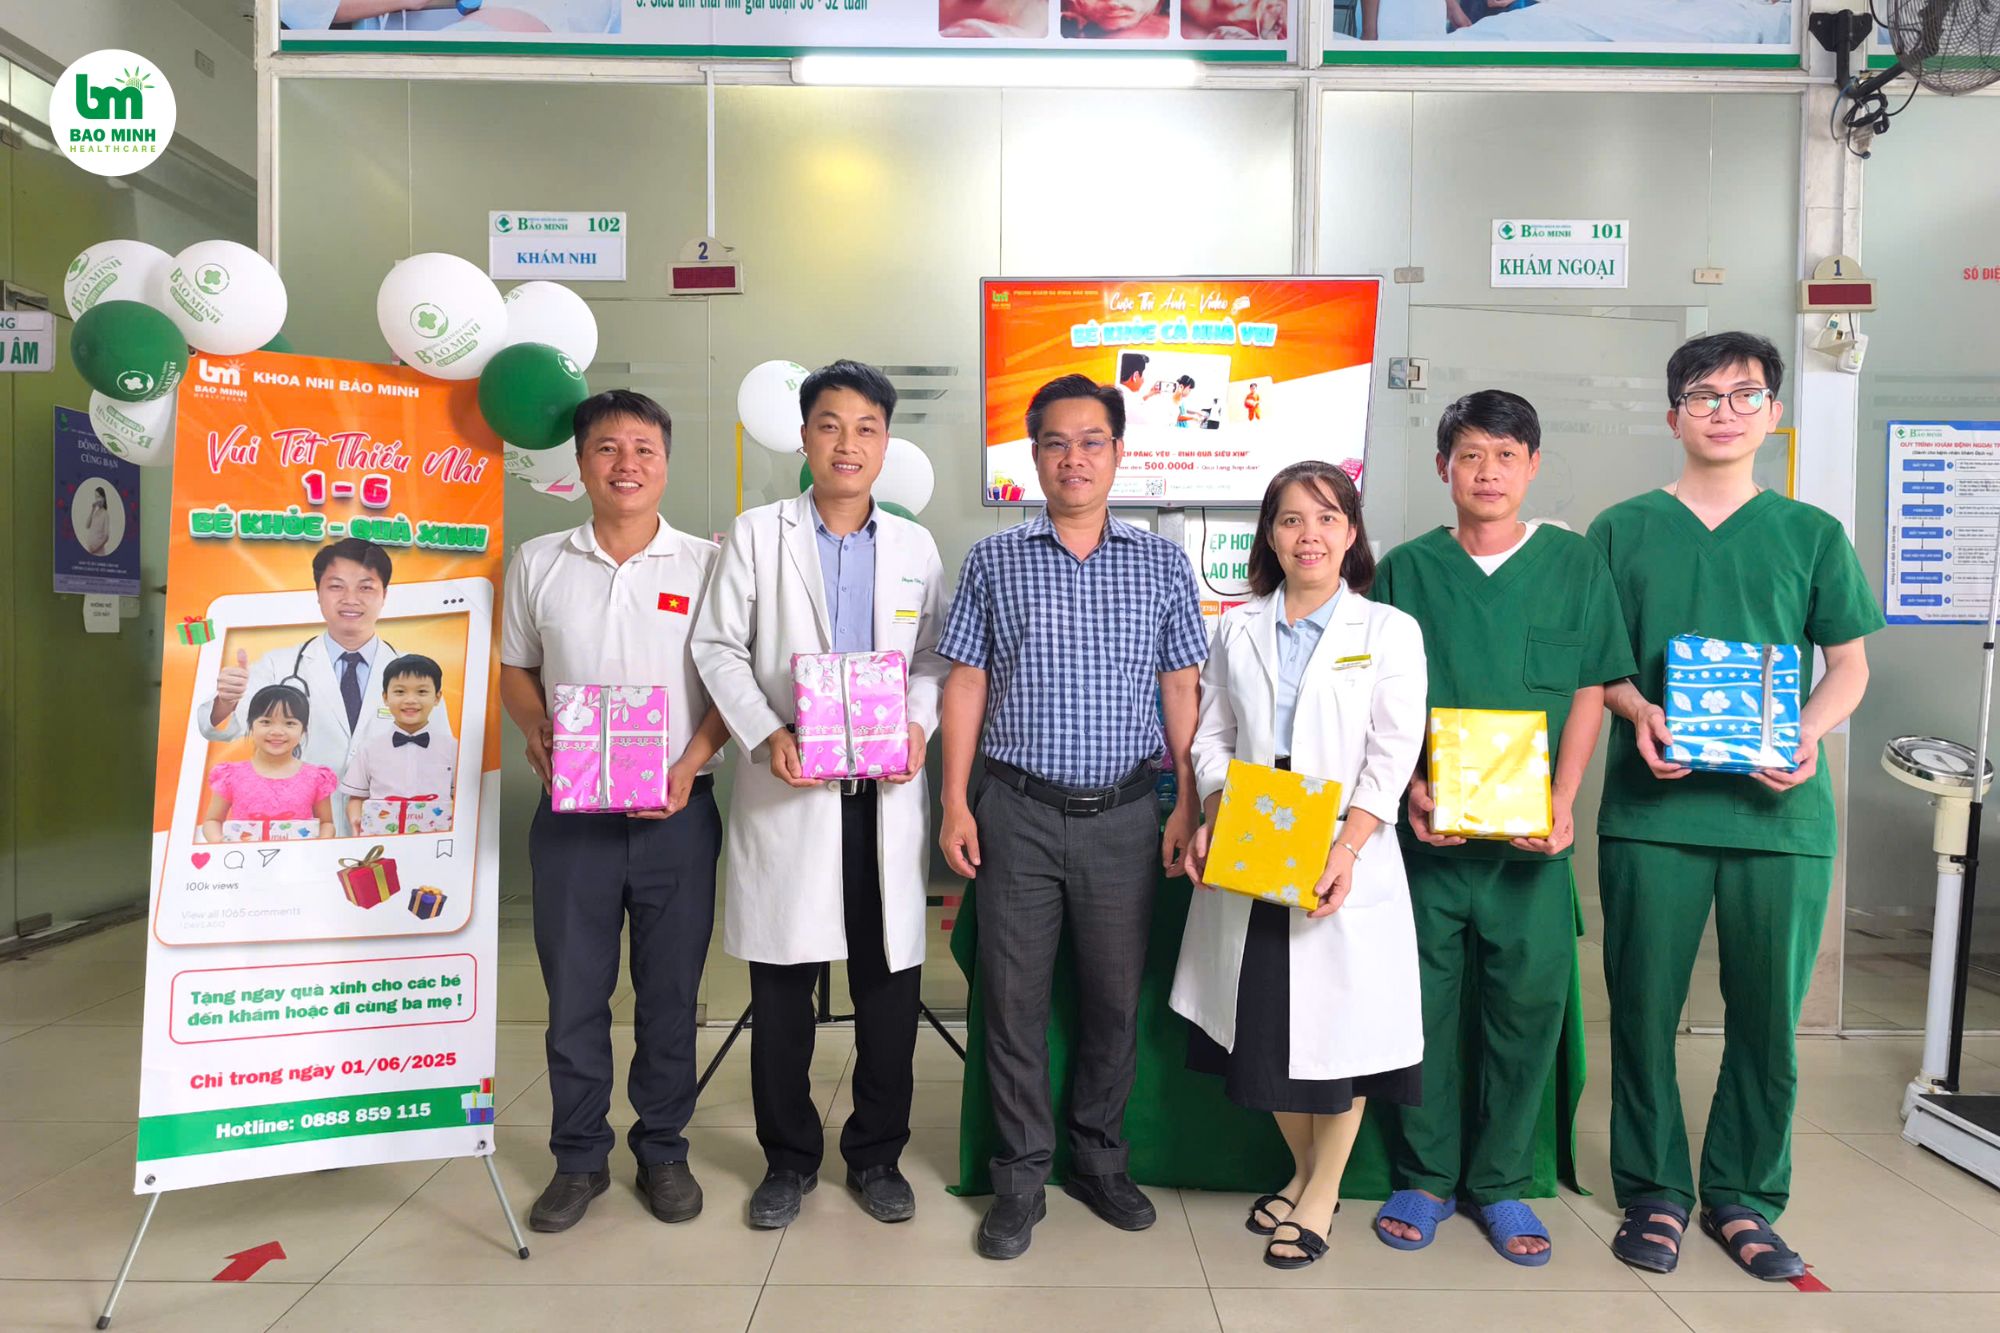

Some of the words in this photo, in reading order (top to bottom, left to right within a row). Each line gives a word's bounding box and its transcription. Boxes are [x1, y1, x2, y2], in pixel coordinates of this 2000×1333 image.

[543, 222, 569, 231] MINH
[587, 216, 621, 233] 102
[1546, 229, 1572, 238] MINH
[1591, 223, 1623, 239] 101
[516, 248, 565, 265] KHÁM
[568, 251, 598, 265] NHI
[698, 241, 709, 260] 2
[1499, 253, 1553, 276] KHÁM
[1556, 258, 1616, 281] NGOẠI
[1833, 259, 1843, 277] 1
[1963, 264, 1979, 281] SỐ
[189, 295, 222, 325] MINH
[10, 336, 39, 364] ÂM
[450, 322, 482, 350] MINH
[194, 384, 217, 394] BAO
[219, 386, 248, 398] MINH
[252, 371, 300, 387] KHOA
[305, 376, 334, 390] NHI
[338, 378, 374, 394] BẢO
[377, 383, 420, 398] MINH
[208, 424, 261, 474] Vui
[271, 427, 329, 467] Tết
[330, 431, 412, 473] Thiếu
[422, 446, 489, 483] Nhi
[301, 469, 326, 505] 1
[359, 473, 392, 509] 6
[189, 503, 236, 540] BÉ
[237, 504, 326, 540] KHỎE
[349, 512, 415, 548] QUÀ
[414, 520, 491, 552] XINH
[185, 881, 210, 891] 100k
[212, 882, 239, 891] views
[190, 989, 237, 1007] Tặng
[241, 987, 286, 1004] ngay
[290, 983, 325, 1000] quà
[329, 980, 367, 995] xinh
[371, 978, 403, 992] cho
[407, 976, 437, 990] các
[440, 974, 462, 988] bé
[187, 1011, 223, 1027] đến
[228, 1008, 280, 1024] khám
[285, 1004, 329, 1020] hoặc
[333, 1001, 350, 1016] đi
[355, 999, 398, 1014] cùng
[401, 997, 423, 1010] ba
[426, 996, 453, 1010] mẹ
[189, 1071, 223, 1090] Chỉ
[229, 1067, 284, 1087] trong
[288, 1063, 336, 1083] ngày
[341, 1051, 457, 1077] 01/06/2025
[215, 1116, 295, 1139] Hotline:
[300, 1109, 350, 1130] 0888
[355, 1104, 392, 1123] 859
[395, 1101, 432, 1120] 115
